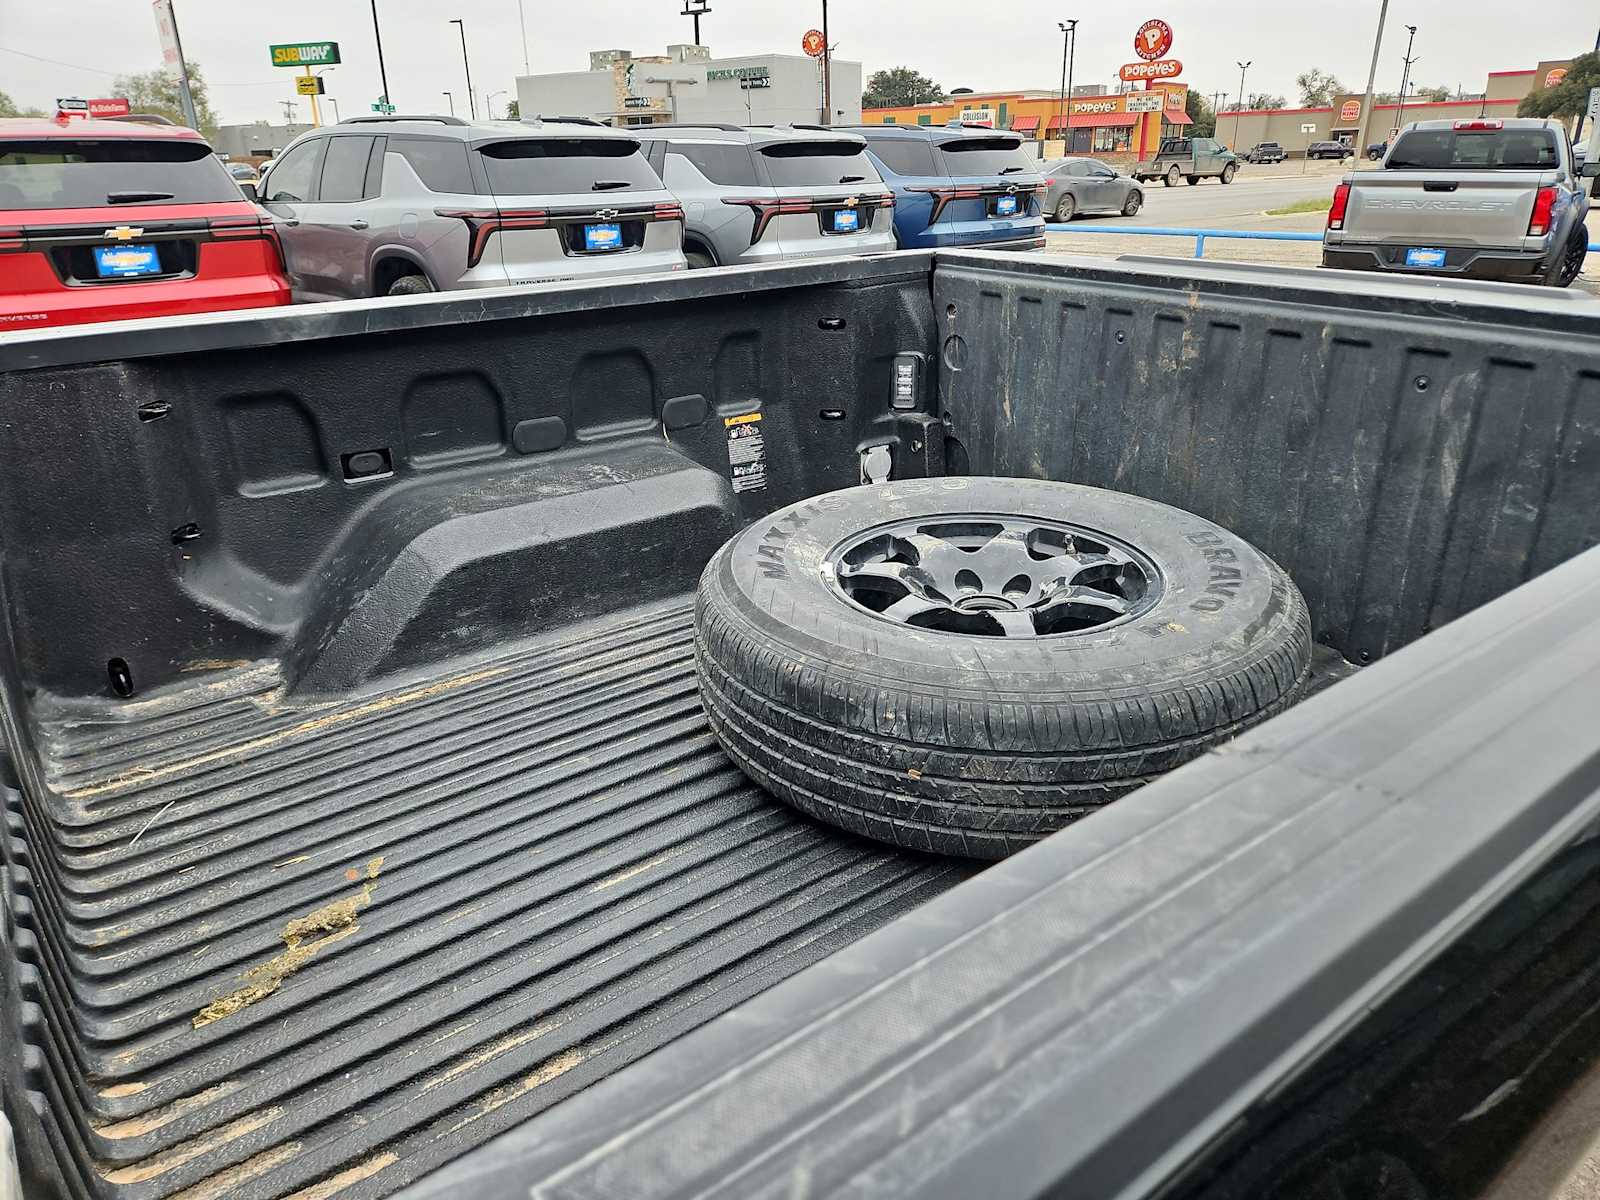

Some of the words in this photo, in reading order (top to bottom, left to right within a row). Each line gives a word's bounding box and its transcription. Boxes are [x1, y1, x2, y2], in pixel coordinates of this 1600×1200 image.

[1136, 20, 1169, 38] LOUISIANA
[274, 46, 330, 62] SUBWAY
[1137, 43, 1166, 59] KITCHEN
[1124, 61, 1177, 77] POPEYES
[1074, 101, 1118, 112] POPEYES
[962, 111, 989, 121] COLLISION
[1364, 200, 1513, 212] CHEVROLET
[1184, 531, 1242, 613] BRAVO
